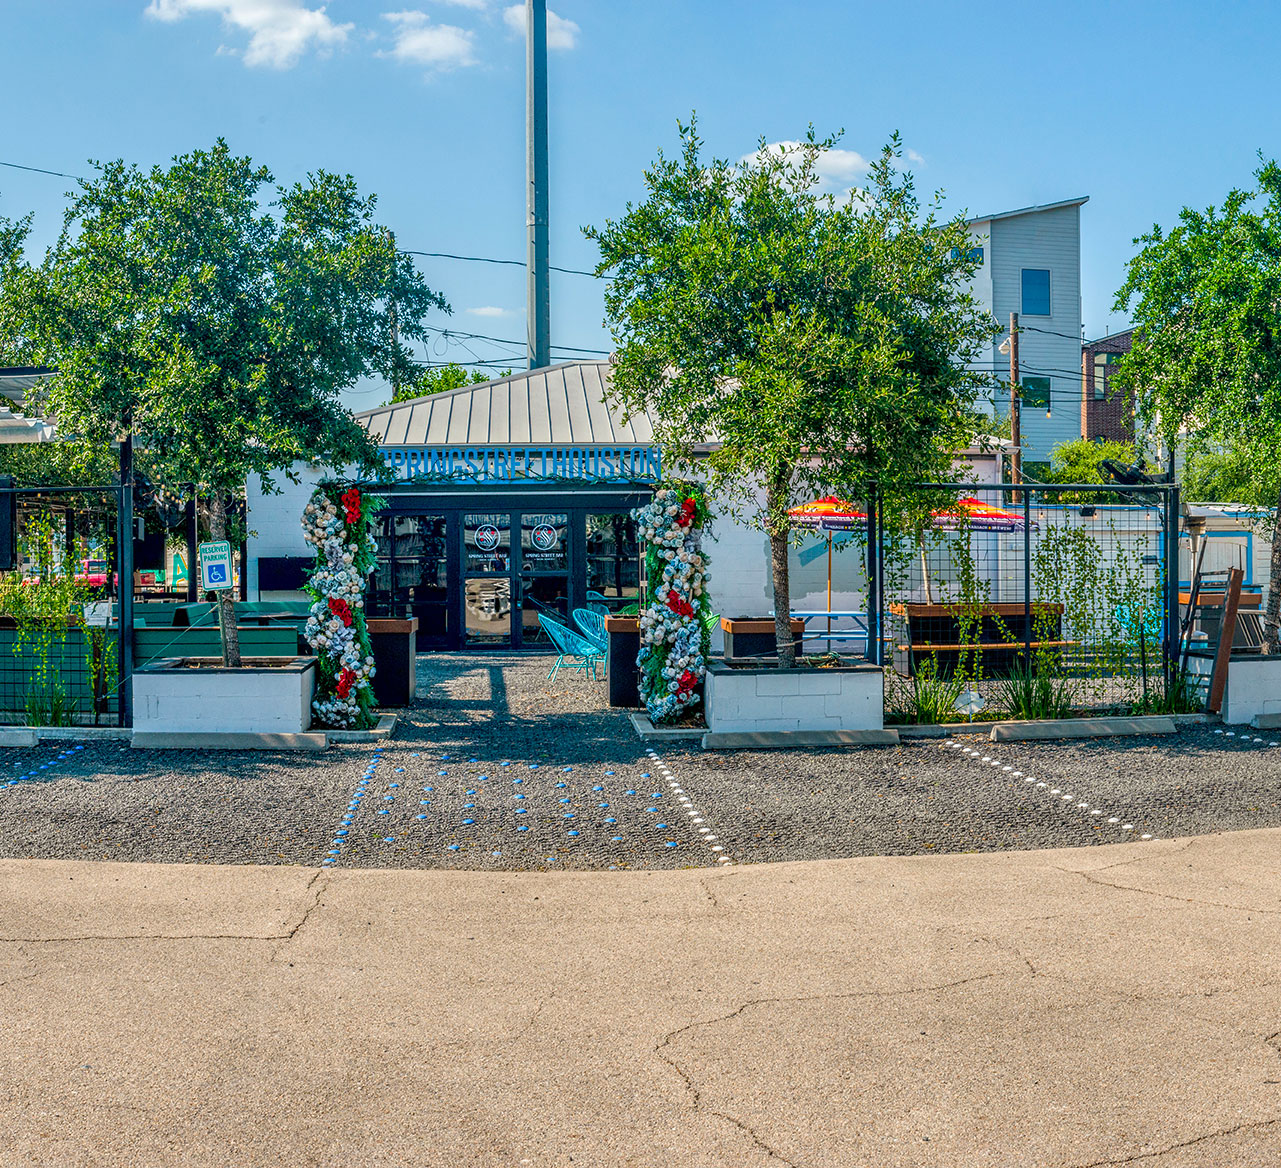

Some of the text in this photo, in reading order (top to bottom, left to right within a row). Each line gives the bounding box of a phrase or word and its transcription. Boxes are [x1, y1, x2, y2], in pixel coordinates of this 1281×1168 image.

[356, 447, 662, 483] PRINGSTREETHOUSTON
[201, 545, 228, 554] RESERVED
[203, 553, 228, 562] PARKING
